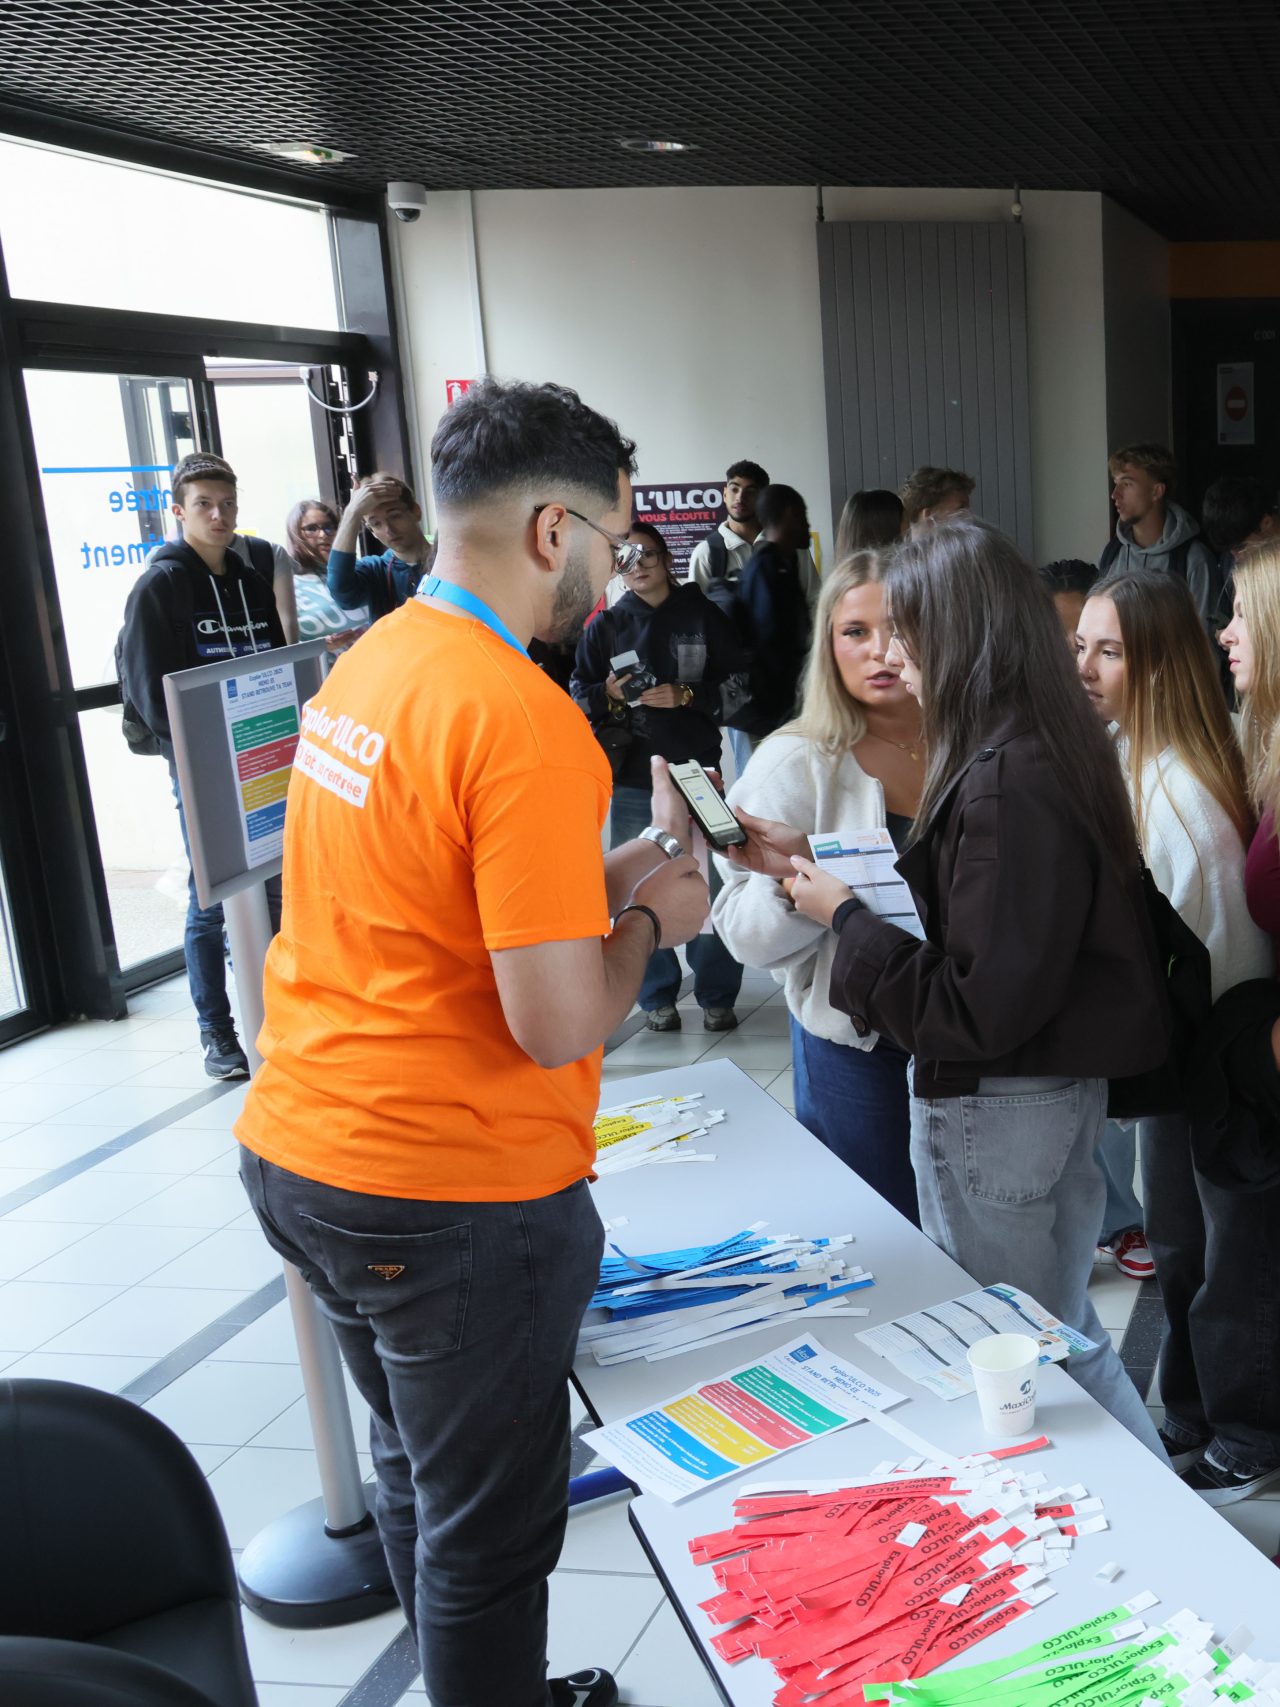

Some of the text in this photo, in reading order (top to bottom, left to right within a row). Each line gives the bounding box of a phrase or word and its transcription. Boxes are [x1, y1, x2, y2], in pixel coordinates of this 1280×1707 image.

[635, 489, 722, 511] L'ULCO
[638, 513, 667, 522] VOUS
[669, 511, 709, 521] ÉCOUTE
[197, 619, 268, 637] Champion
[302, 706, 385, 766] xplor'ULCO
[865, 1483, 941, 1495] Explor'ULCO
[920, 1514, 989, 1554] Explor'ULCO
[855, 1550, 902, 1607] Explor'ULCO
[913, 1539, 980, 1586] Explor'ULCO
[904, 1566, 976, 1607] Explor'ULCO
[901, 1609, 946, 1665] Explor'ULCO
[948, 1606, 1019, 1651] Explor'ULCO
[1042, 1611, 1118, 1650] Explor'ULCO
[1088, 1640, 1164, 1679] Explor'ULCO
